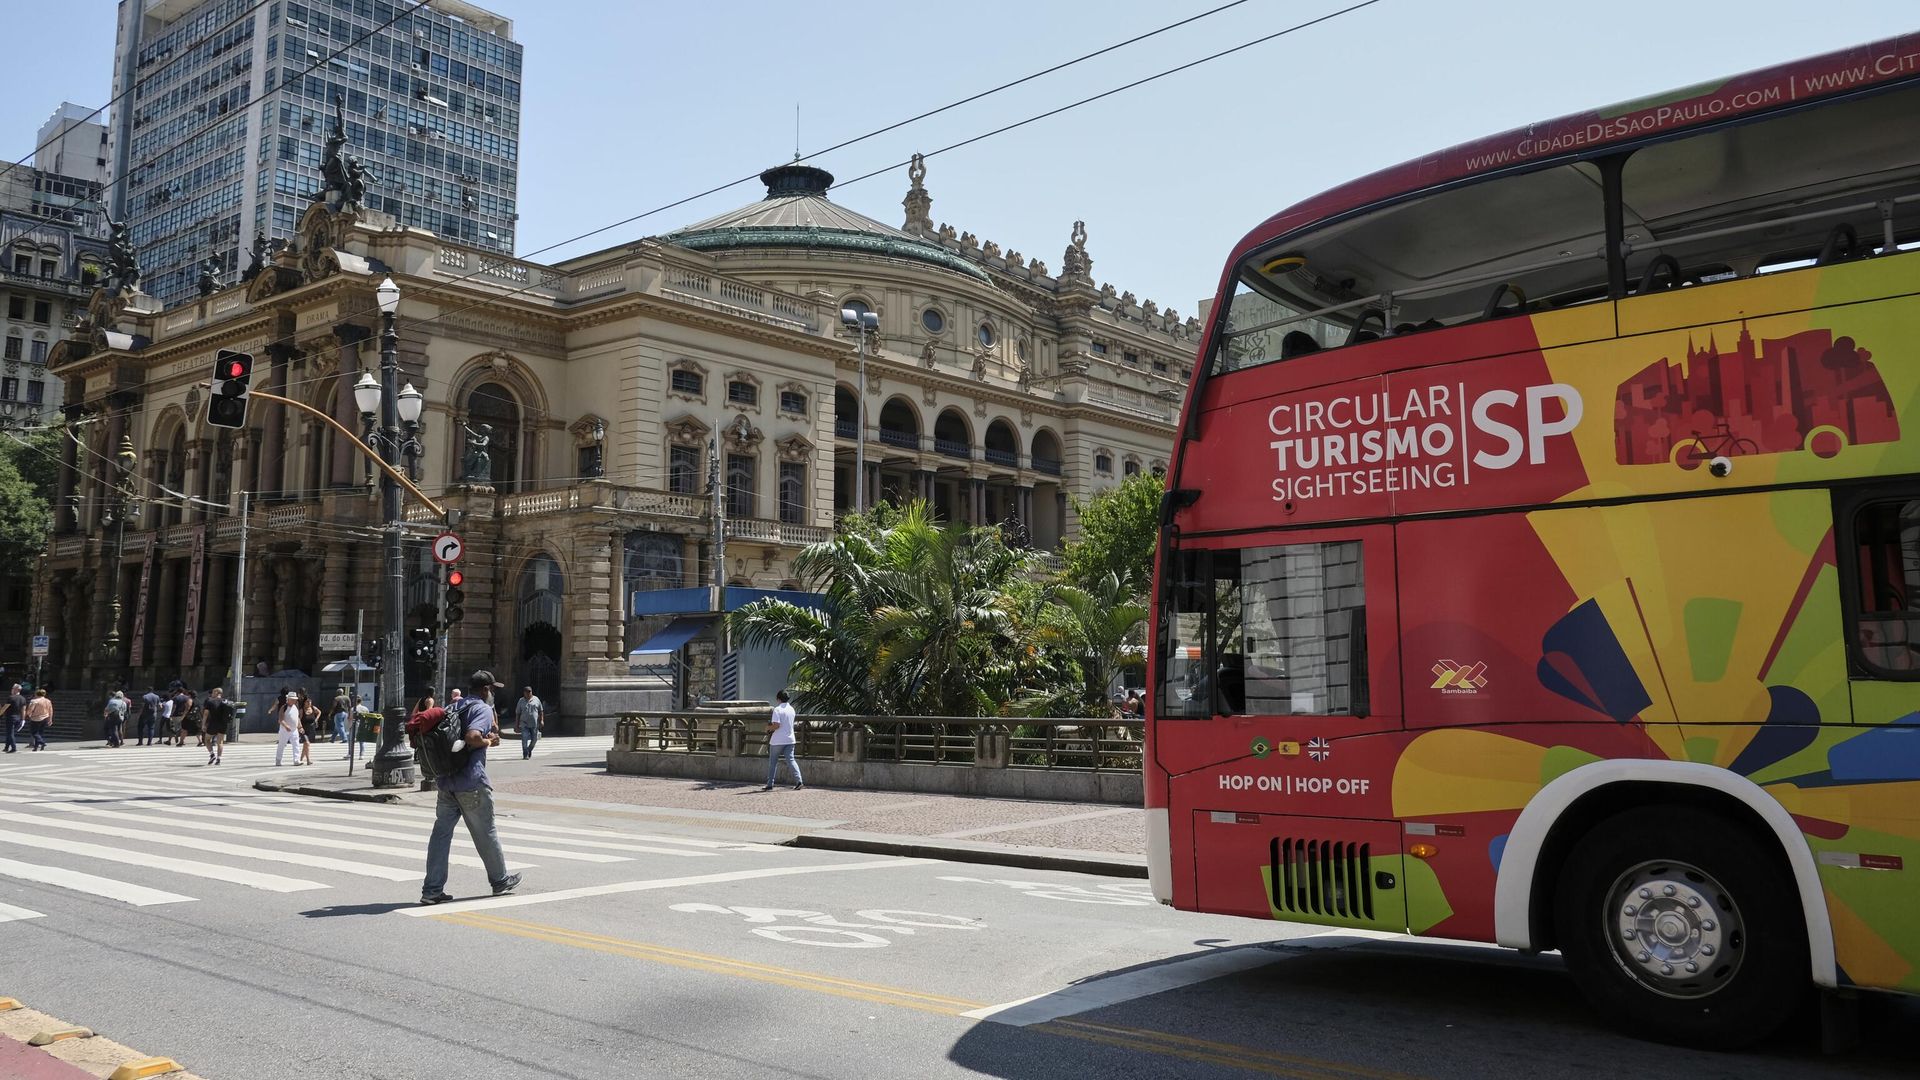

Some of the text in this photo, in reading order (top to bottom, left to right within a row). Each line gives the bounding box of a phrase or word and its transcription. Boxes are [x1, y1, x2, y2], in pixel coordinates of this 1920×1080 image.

[1805, 52, 1920, 92] WWW.CIT
[306, 310, 329, 325] DRAMA
[1268, 384, 1452, 436] CIRCULAR
[1471, 383, 1584, 470] SP
[1270, 422, 1454, 472] TURISMO
[1271, 462, 1456, 501] SIGHTSEEING
[1219, 775, 1370, 795] HOP ON HOP OFF
